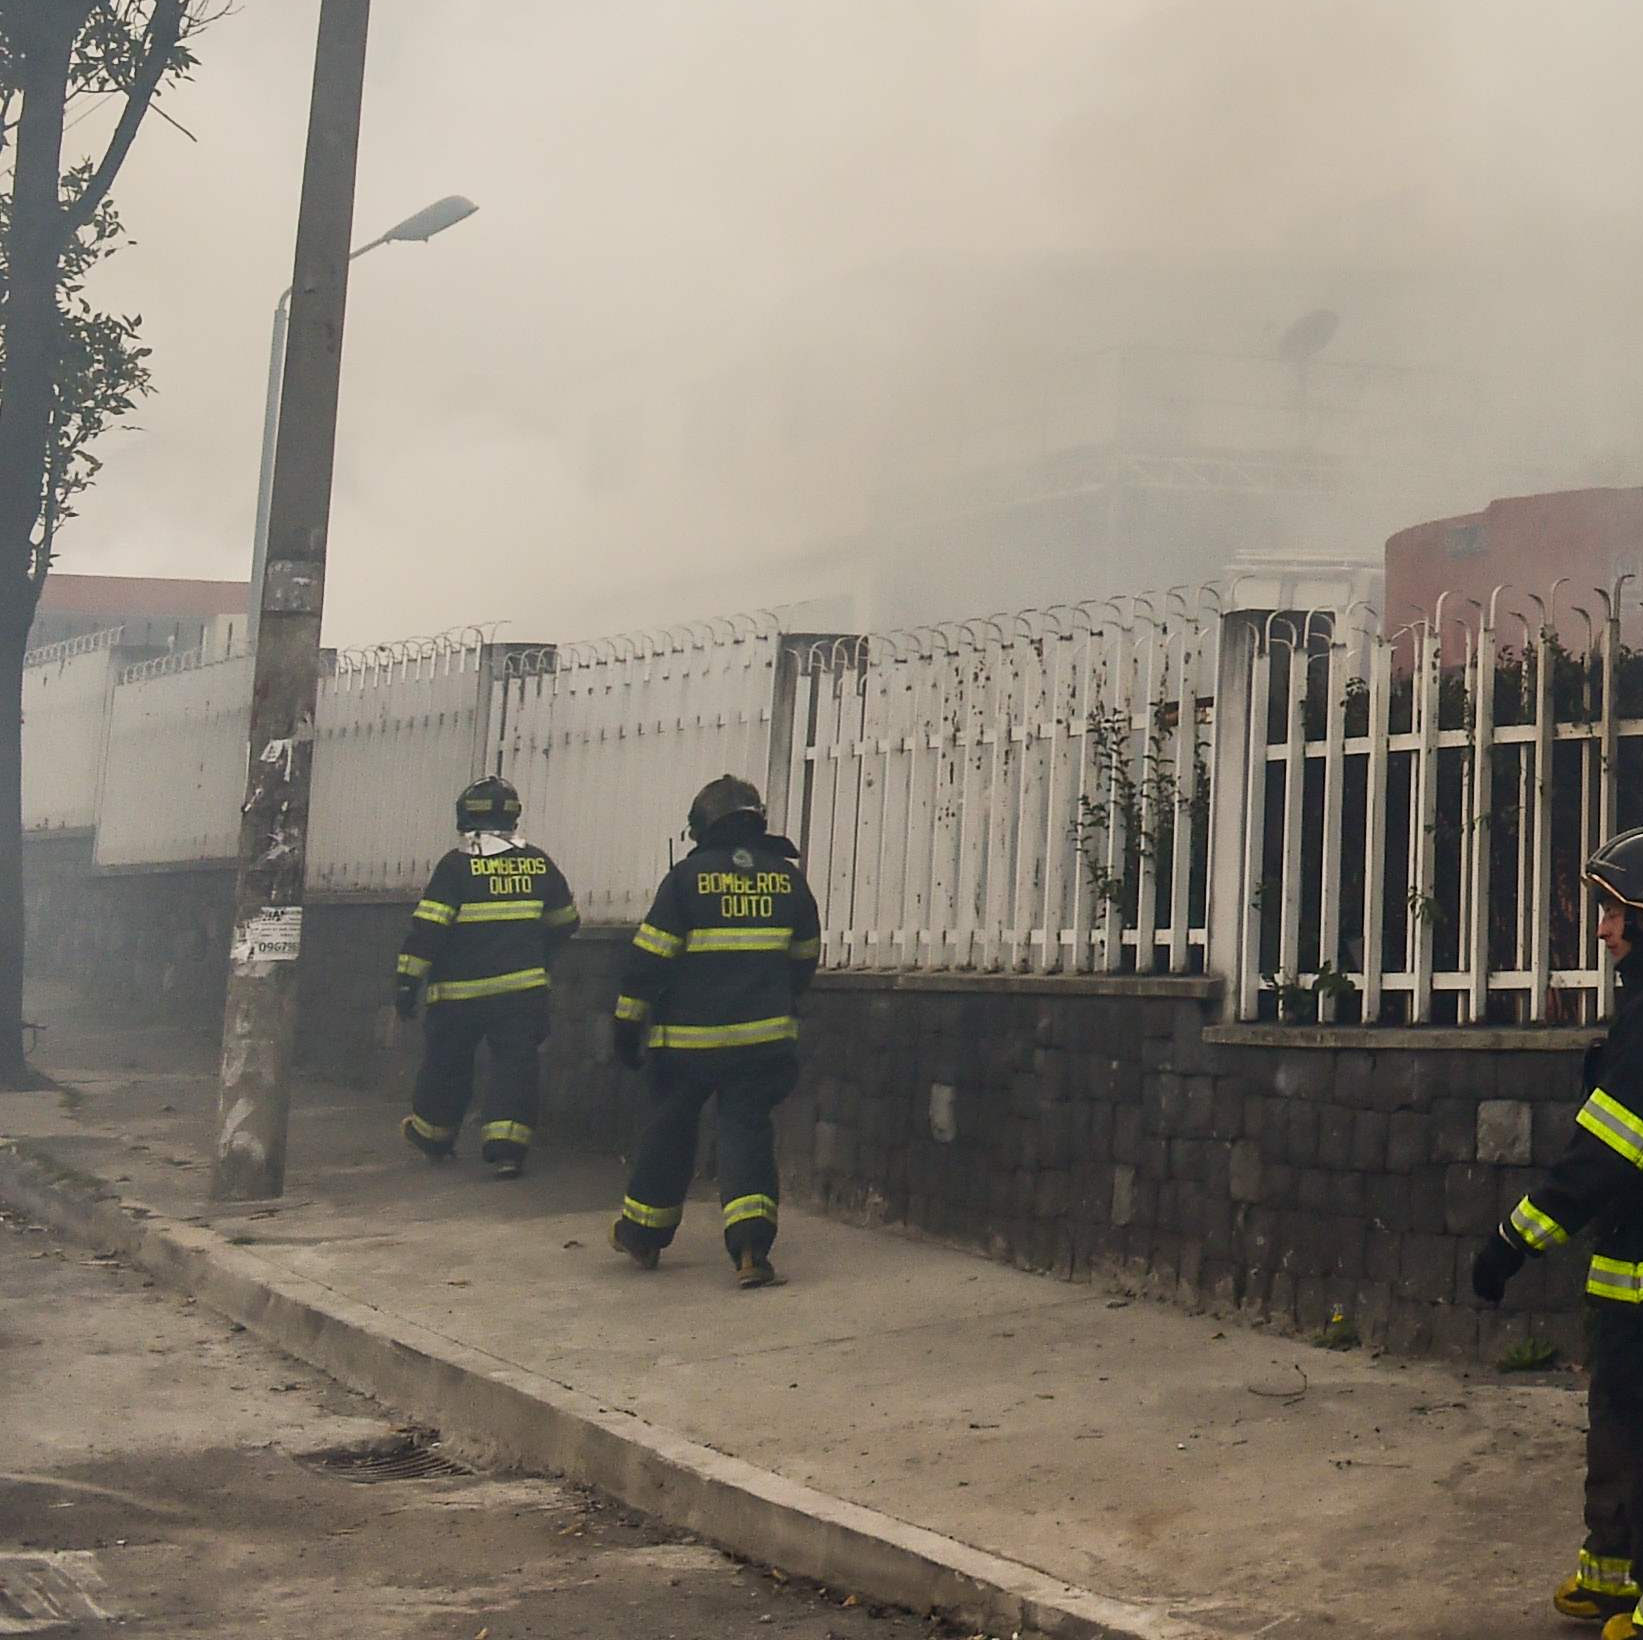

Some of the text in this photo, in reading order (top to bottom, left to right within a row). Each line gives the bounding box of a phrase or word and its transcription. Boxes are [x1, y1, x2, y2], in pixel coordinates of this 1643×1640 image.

[470, 858, 546, 876] BOMBEROS
[490, 875, 532, 895] QUITO
[697, 872, 791, 894] BOMBEROS
[721, 895, 772, 918] QUITO
